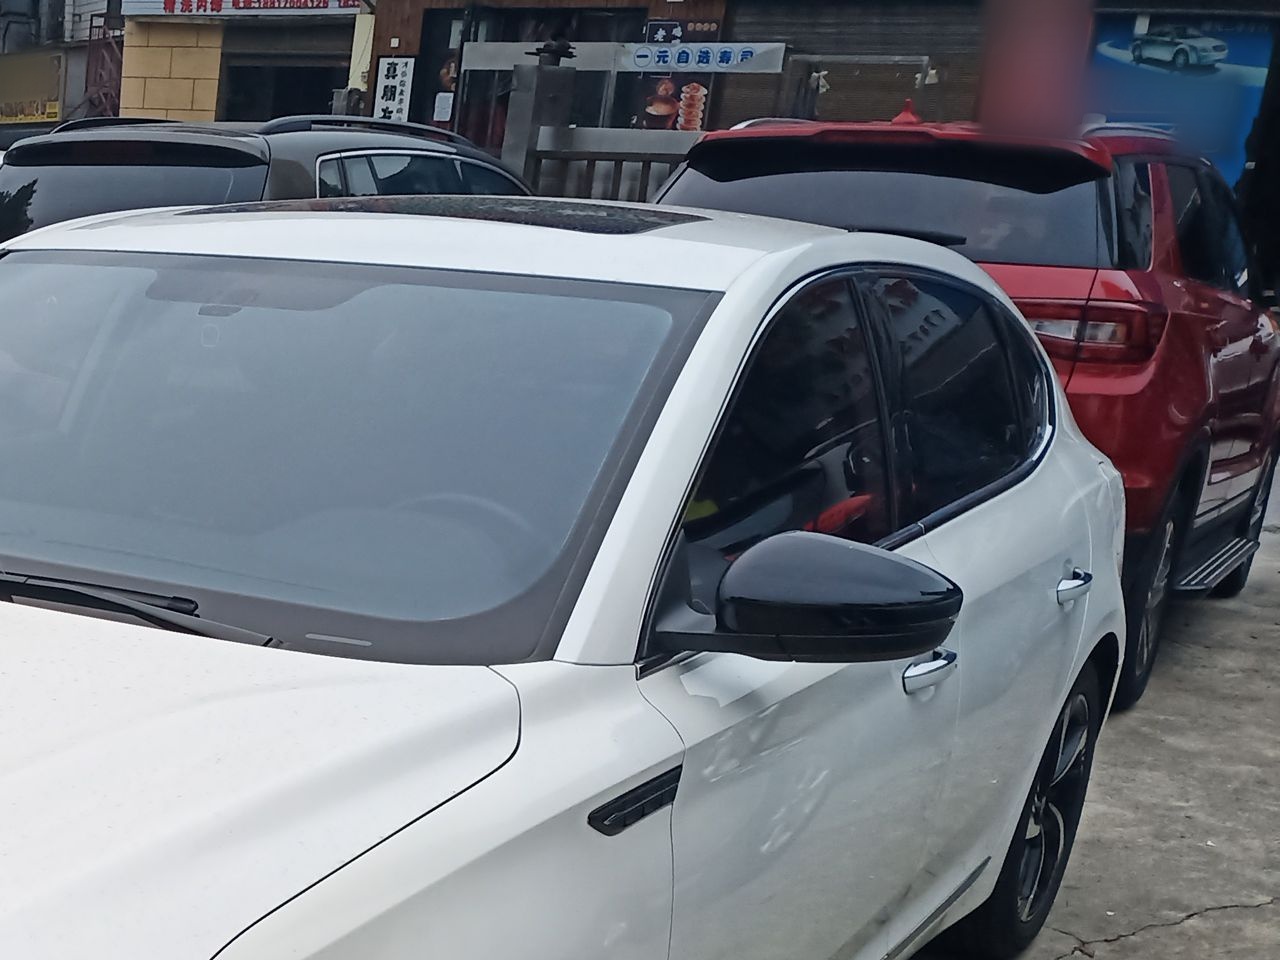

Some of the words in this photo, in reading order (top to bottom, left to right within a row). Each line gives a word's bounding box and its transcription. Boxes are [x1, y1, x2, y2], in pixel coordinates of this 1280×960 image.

[635, 49, 755, 66] 一元自选寿司
